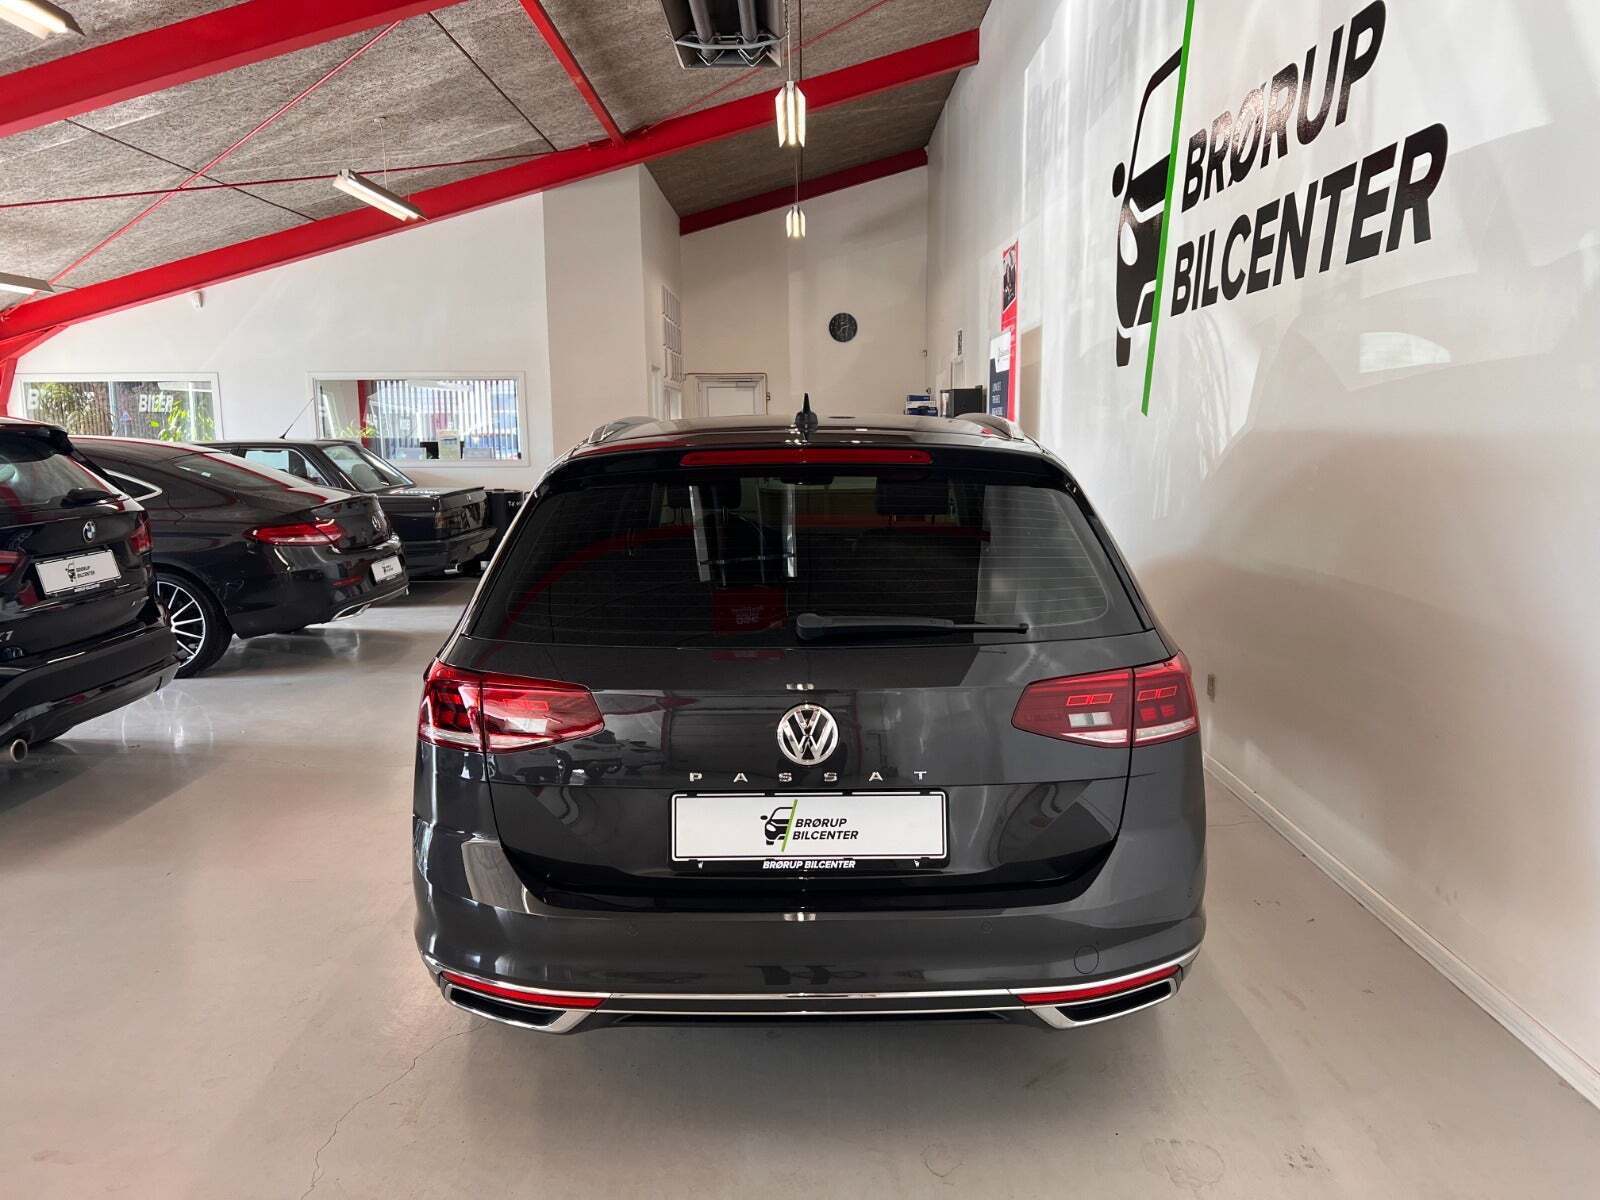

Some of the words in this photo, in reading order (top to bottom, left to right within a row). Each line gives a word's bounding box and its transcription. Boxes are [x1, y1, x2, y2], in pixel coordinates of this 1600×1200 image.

[1181, 0, 1387, 213] BRØRUP
[1170, 122, 1449, 317] BILCENTER
[689, 770, 928, 783] PASSAT
[795, 818, 847, 828] BRØRUP
[792, 830, 859, 840] BILCENTER
[762, 860, 803, 869] BRØRUP
[804, 860, 856, 869] BILCENTER
